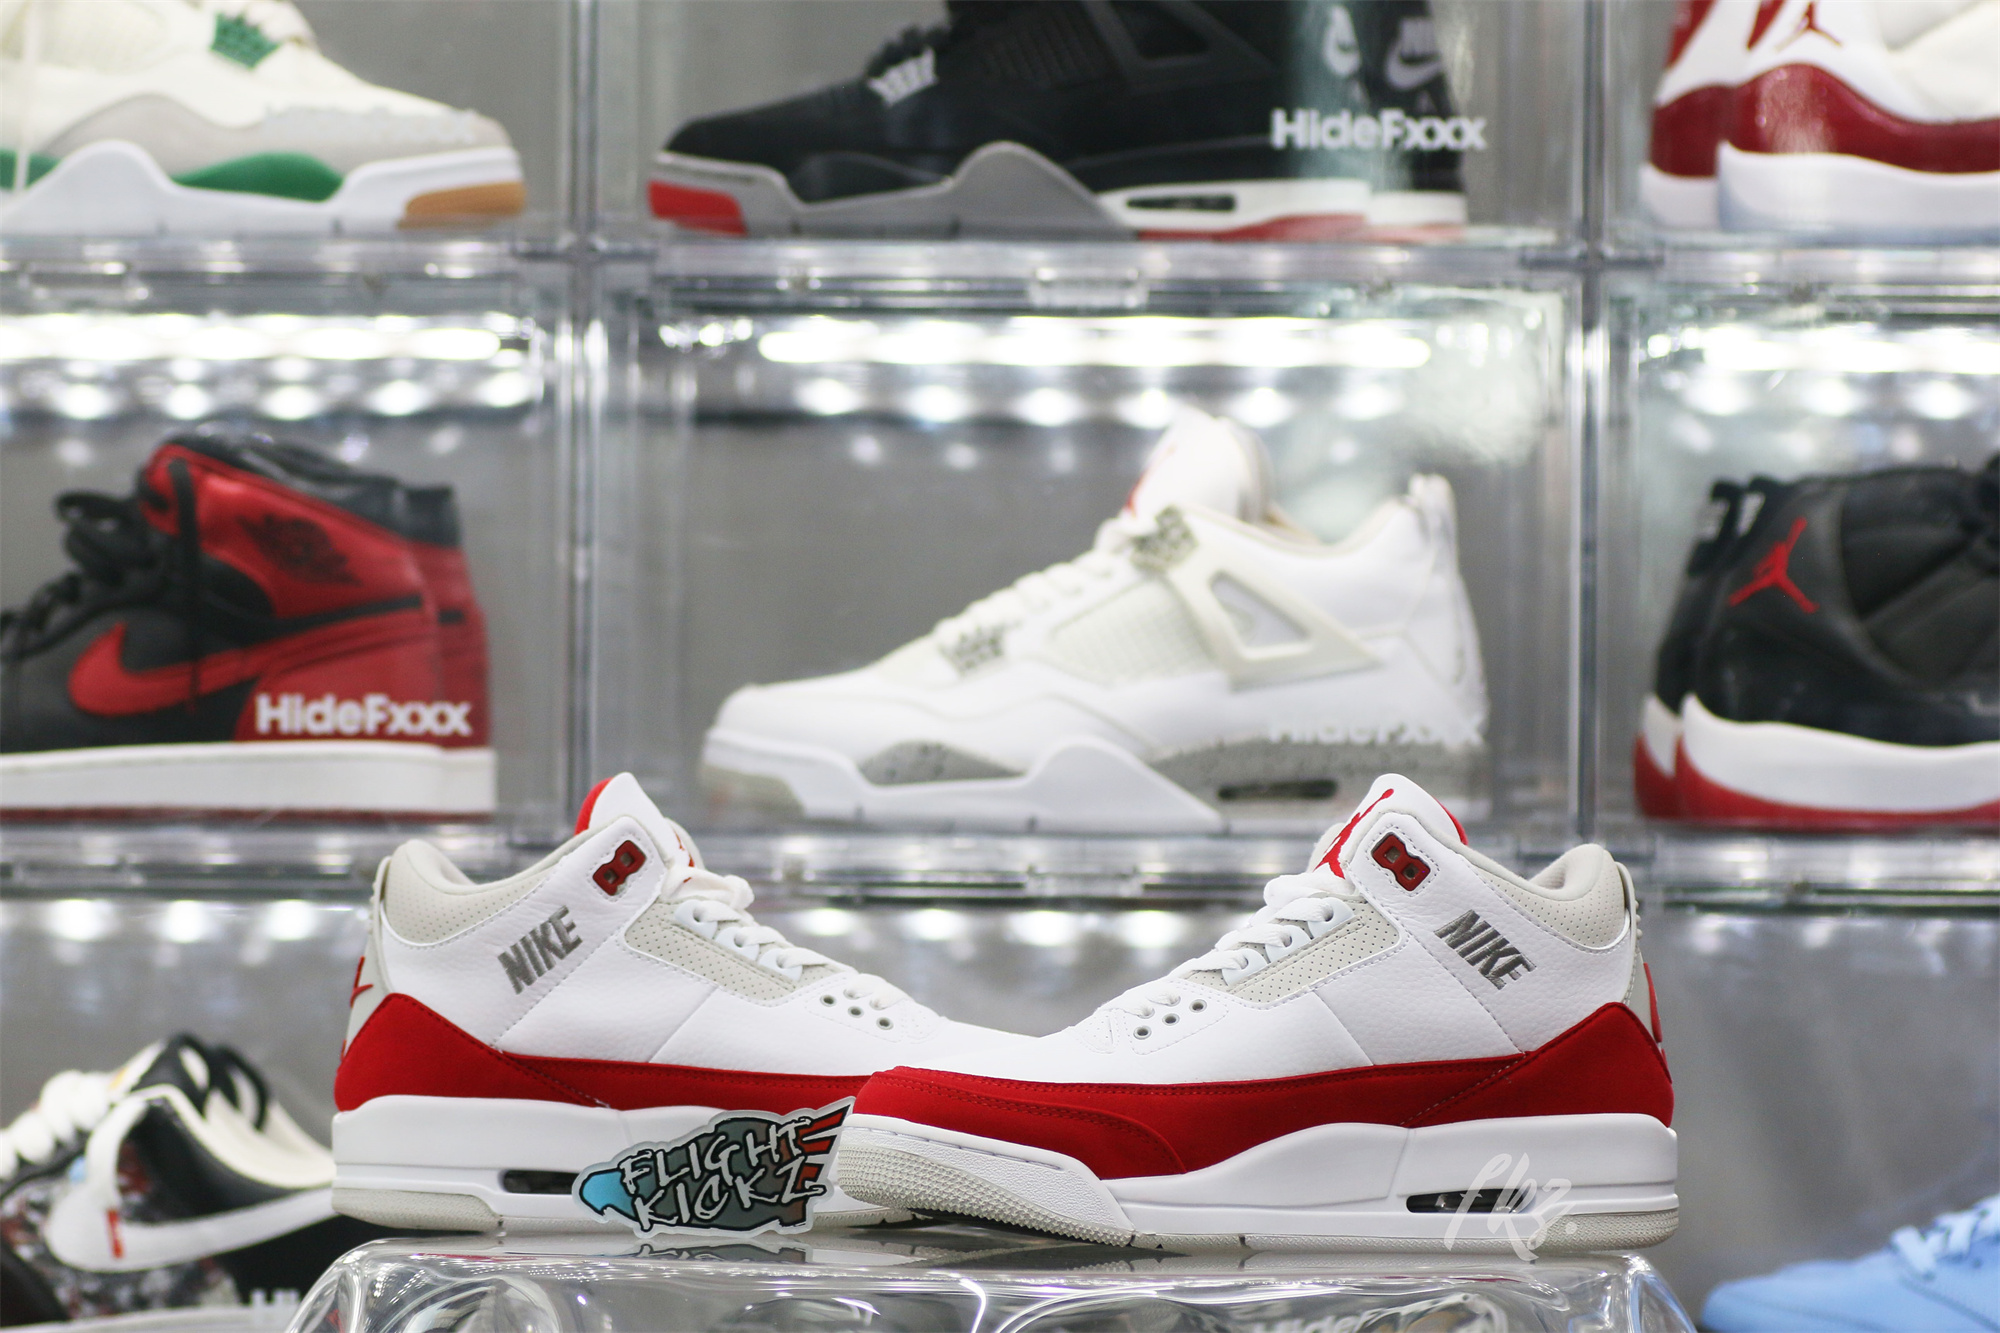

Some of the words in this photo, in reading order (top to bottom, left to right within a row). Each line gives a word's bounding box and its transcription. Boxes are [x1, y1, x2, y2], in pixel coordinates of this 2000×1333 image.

[1271, 108, 1487, 150] HideFxxx
[255, 693, 473, 737] HideFxxx
[498, 905, 583, 995] NIKE
[1433, 909, 1538, 990] NIKE
[619, 1117, 812, 1194] FLIGHT
[634, 1155, 827, 1231] KICKZ
